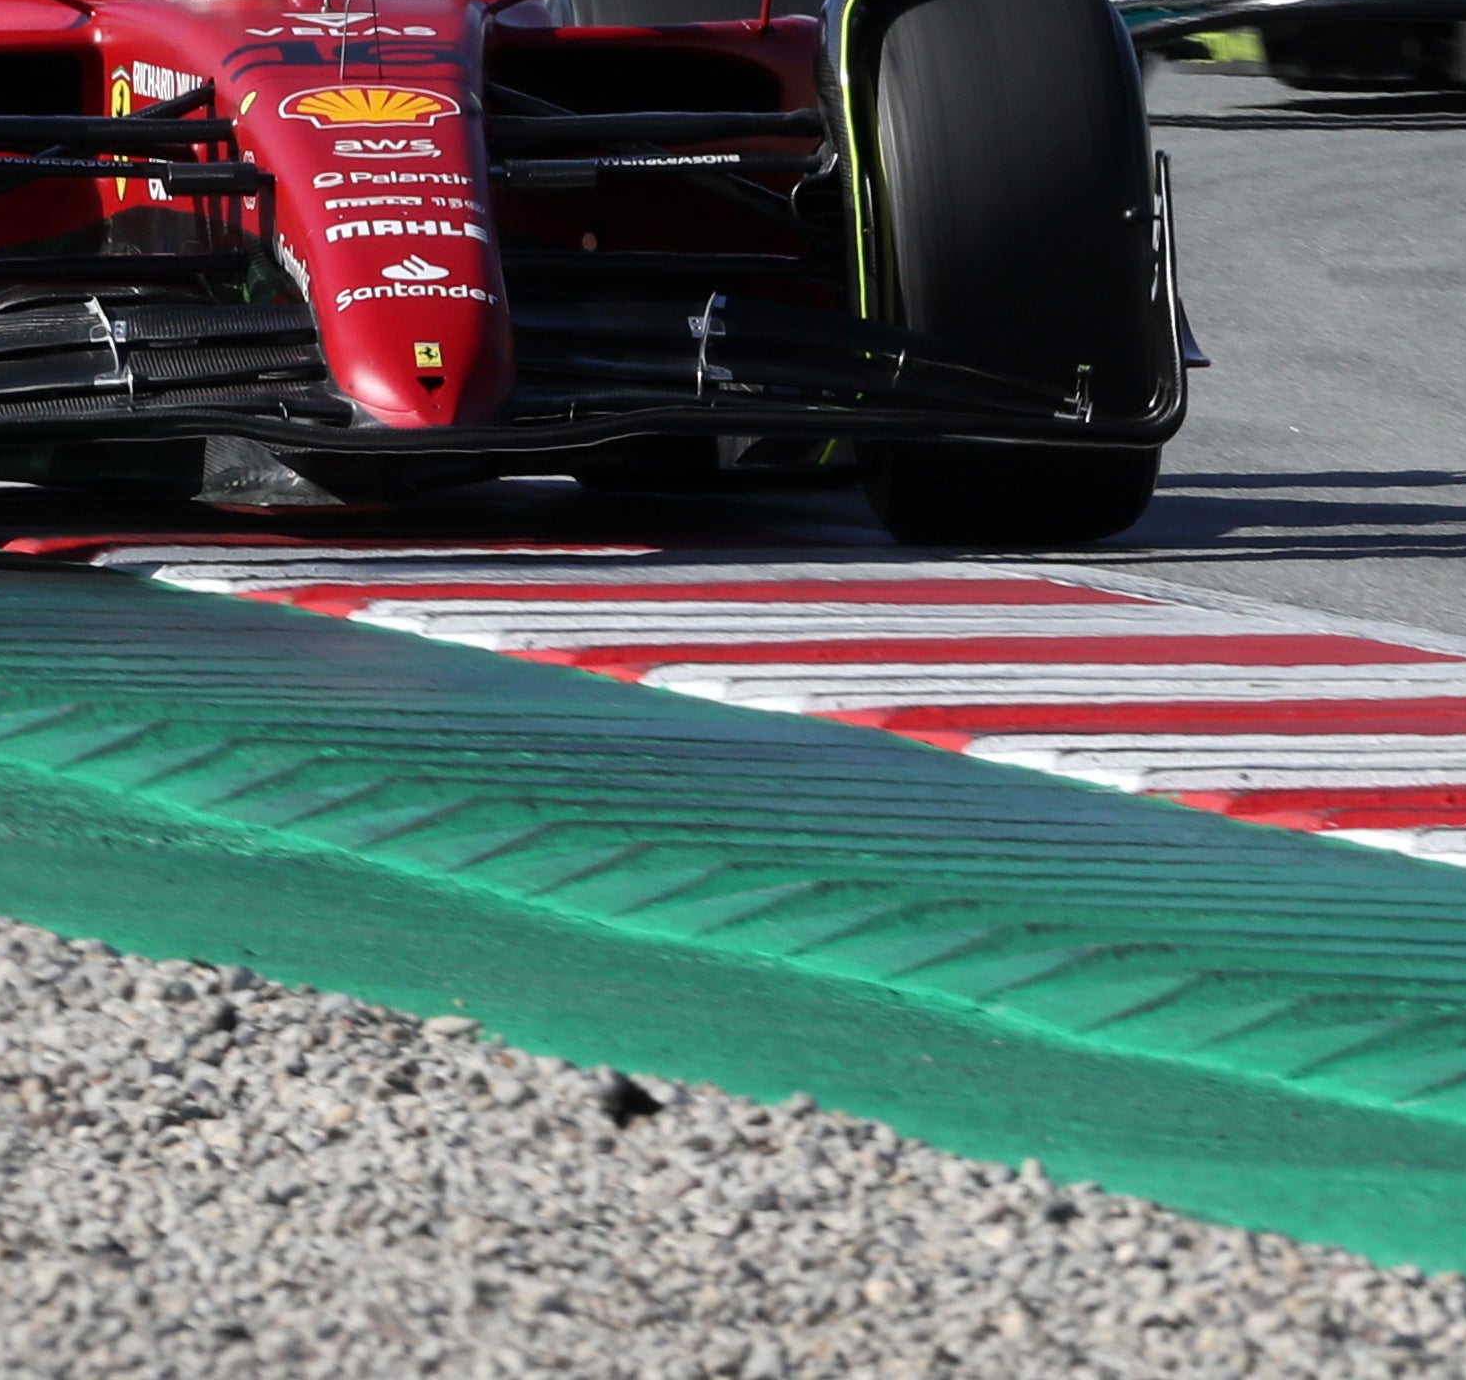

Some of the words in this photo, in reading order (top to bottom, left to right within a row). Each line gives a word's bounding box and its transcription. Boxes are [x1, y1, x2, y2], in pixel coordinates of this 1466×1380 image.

[245, 26, 437, 37] VELAS
[221, 40, 472, 83] 16
[133, 60, 176, 101] RICHARD
[334, 138, 436, 153] aws
[350, 170, 474, 185] Palantir
[325, 220, 489, 244] MAHLE
[335, 282, 499, 312] Santander
